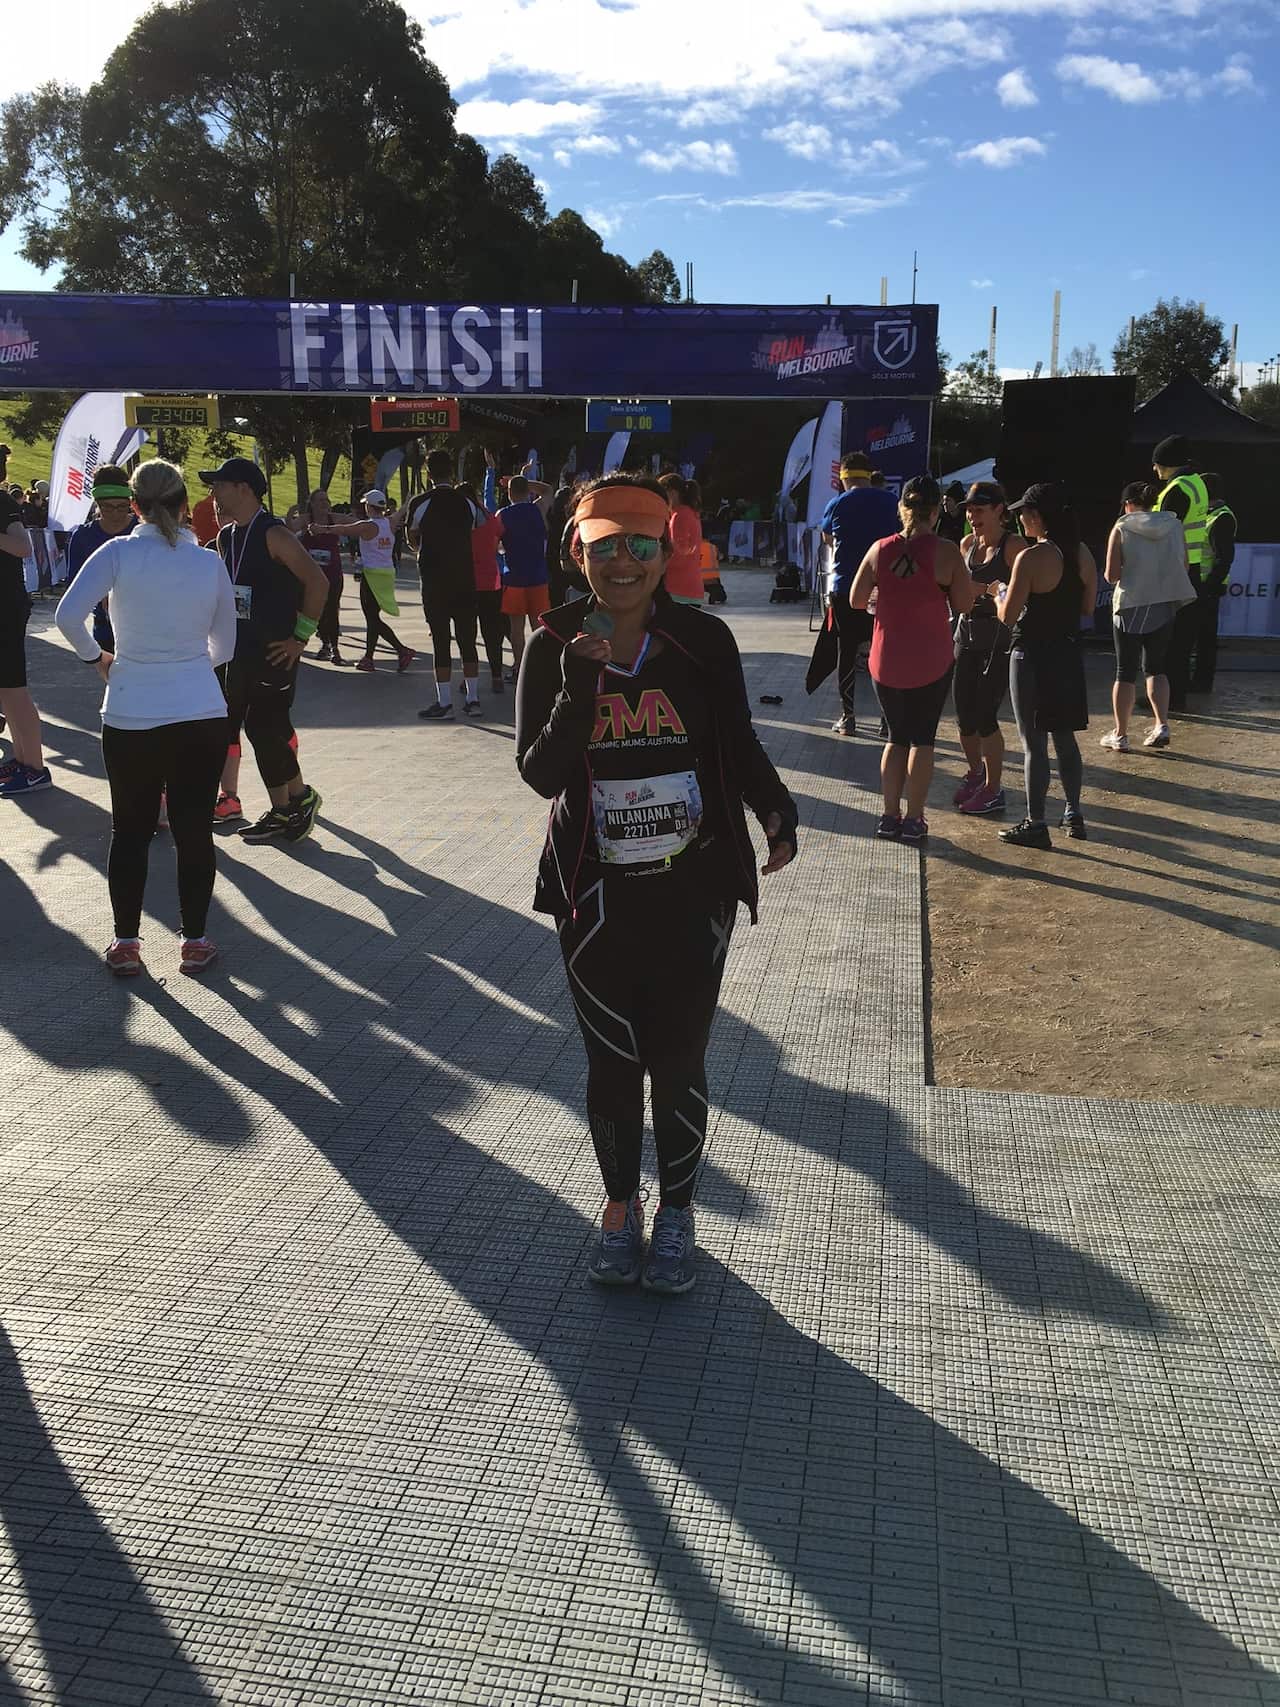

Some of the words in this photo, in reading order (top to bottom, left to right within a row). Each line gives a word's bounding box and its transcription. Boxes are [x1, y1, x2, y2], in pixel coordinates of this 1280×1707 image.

[290, 302, 542, 387] FINISH
[769, 335, 805, 365] RUN
[776, 345, 856, 381] MELBOURNE
[626, 405, 648, 413] EVENT
[870, 431, 918, 453] MELBOURNE
[67, 466, 84, 501] RUN
[591, 689, 687, 742] RMA
[621, 737, 647, 748] MUMS
[646, 735, 688, 747] AUSTRALIA
[607, 806, 672, 825] NILANJANA
[623, 823, 657, 838] 22717
